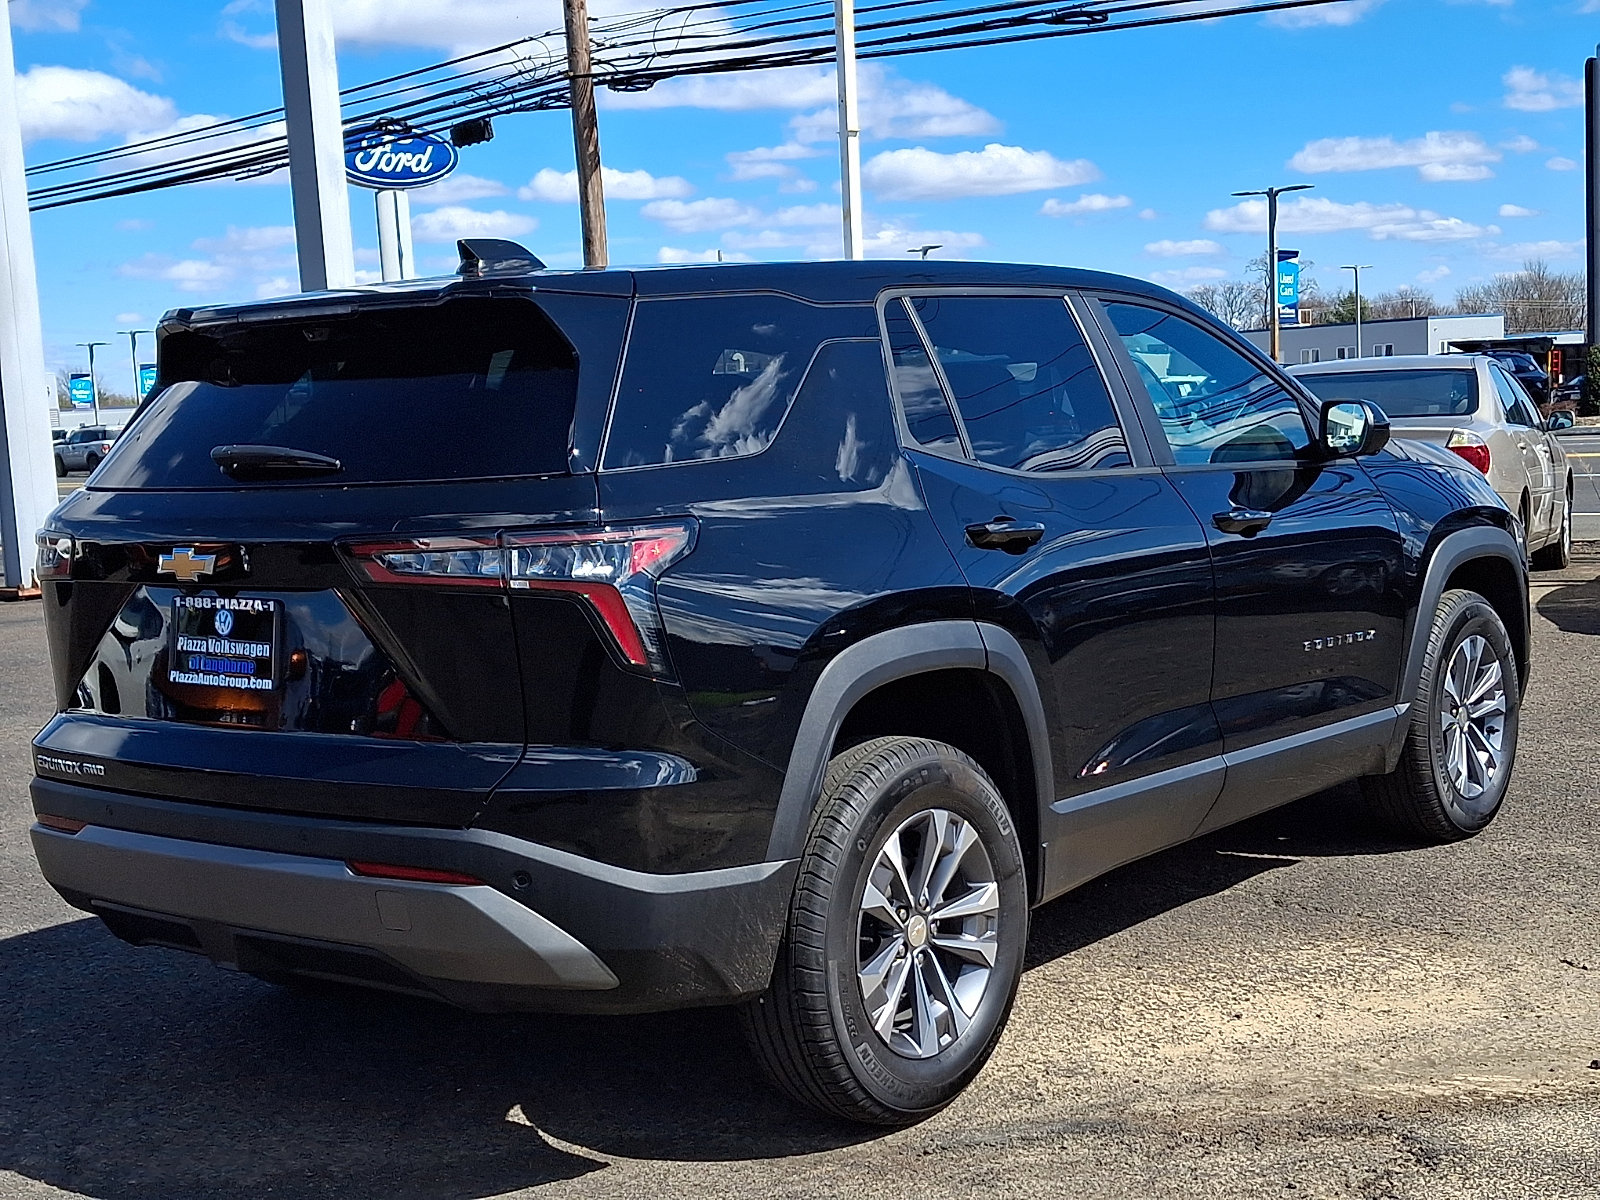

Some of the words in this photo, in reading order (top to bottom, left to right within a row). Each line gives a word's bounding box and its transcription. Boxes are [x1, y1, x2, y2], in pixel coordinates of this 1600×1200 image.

[355, 132, 434, 173] Ford
[1280, 273, 1294, 284] Used
[1280, 285, 1294, 296] Cars
[174, 597, 275, 612] 1-888-PIAZZA-1
[177, 637, 207, 653] Piazza
[208, 638, 270, 658] Volkswagen
[1302, 629, 1377, 652] EQUINOX
[189, 656, 200, 669] of
[200, 656, 255, 674] Langhorne
[170, 670, 273, 690] PiazzaAutoGroup.com
[37, 754, 82, 775] EQUINOX
